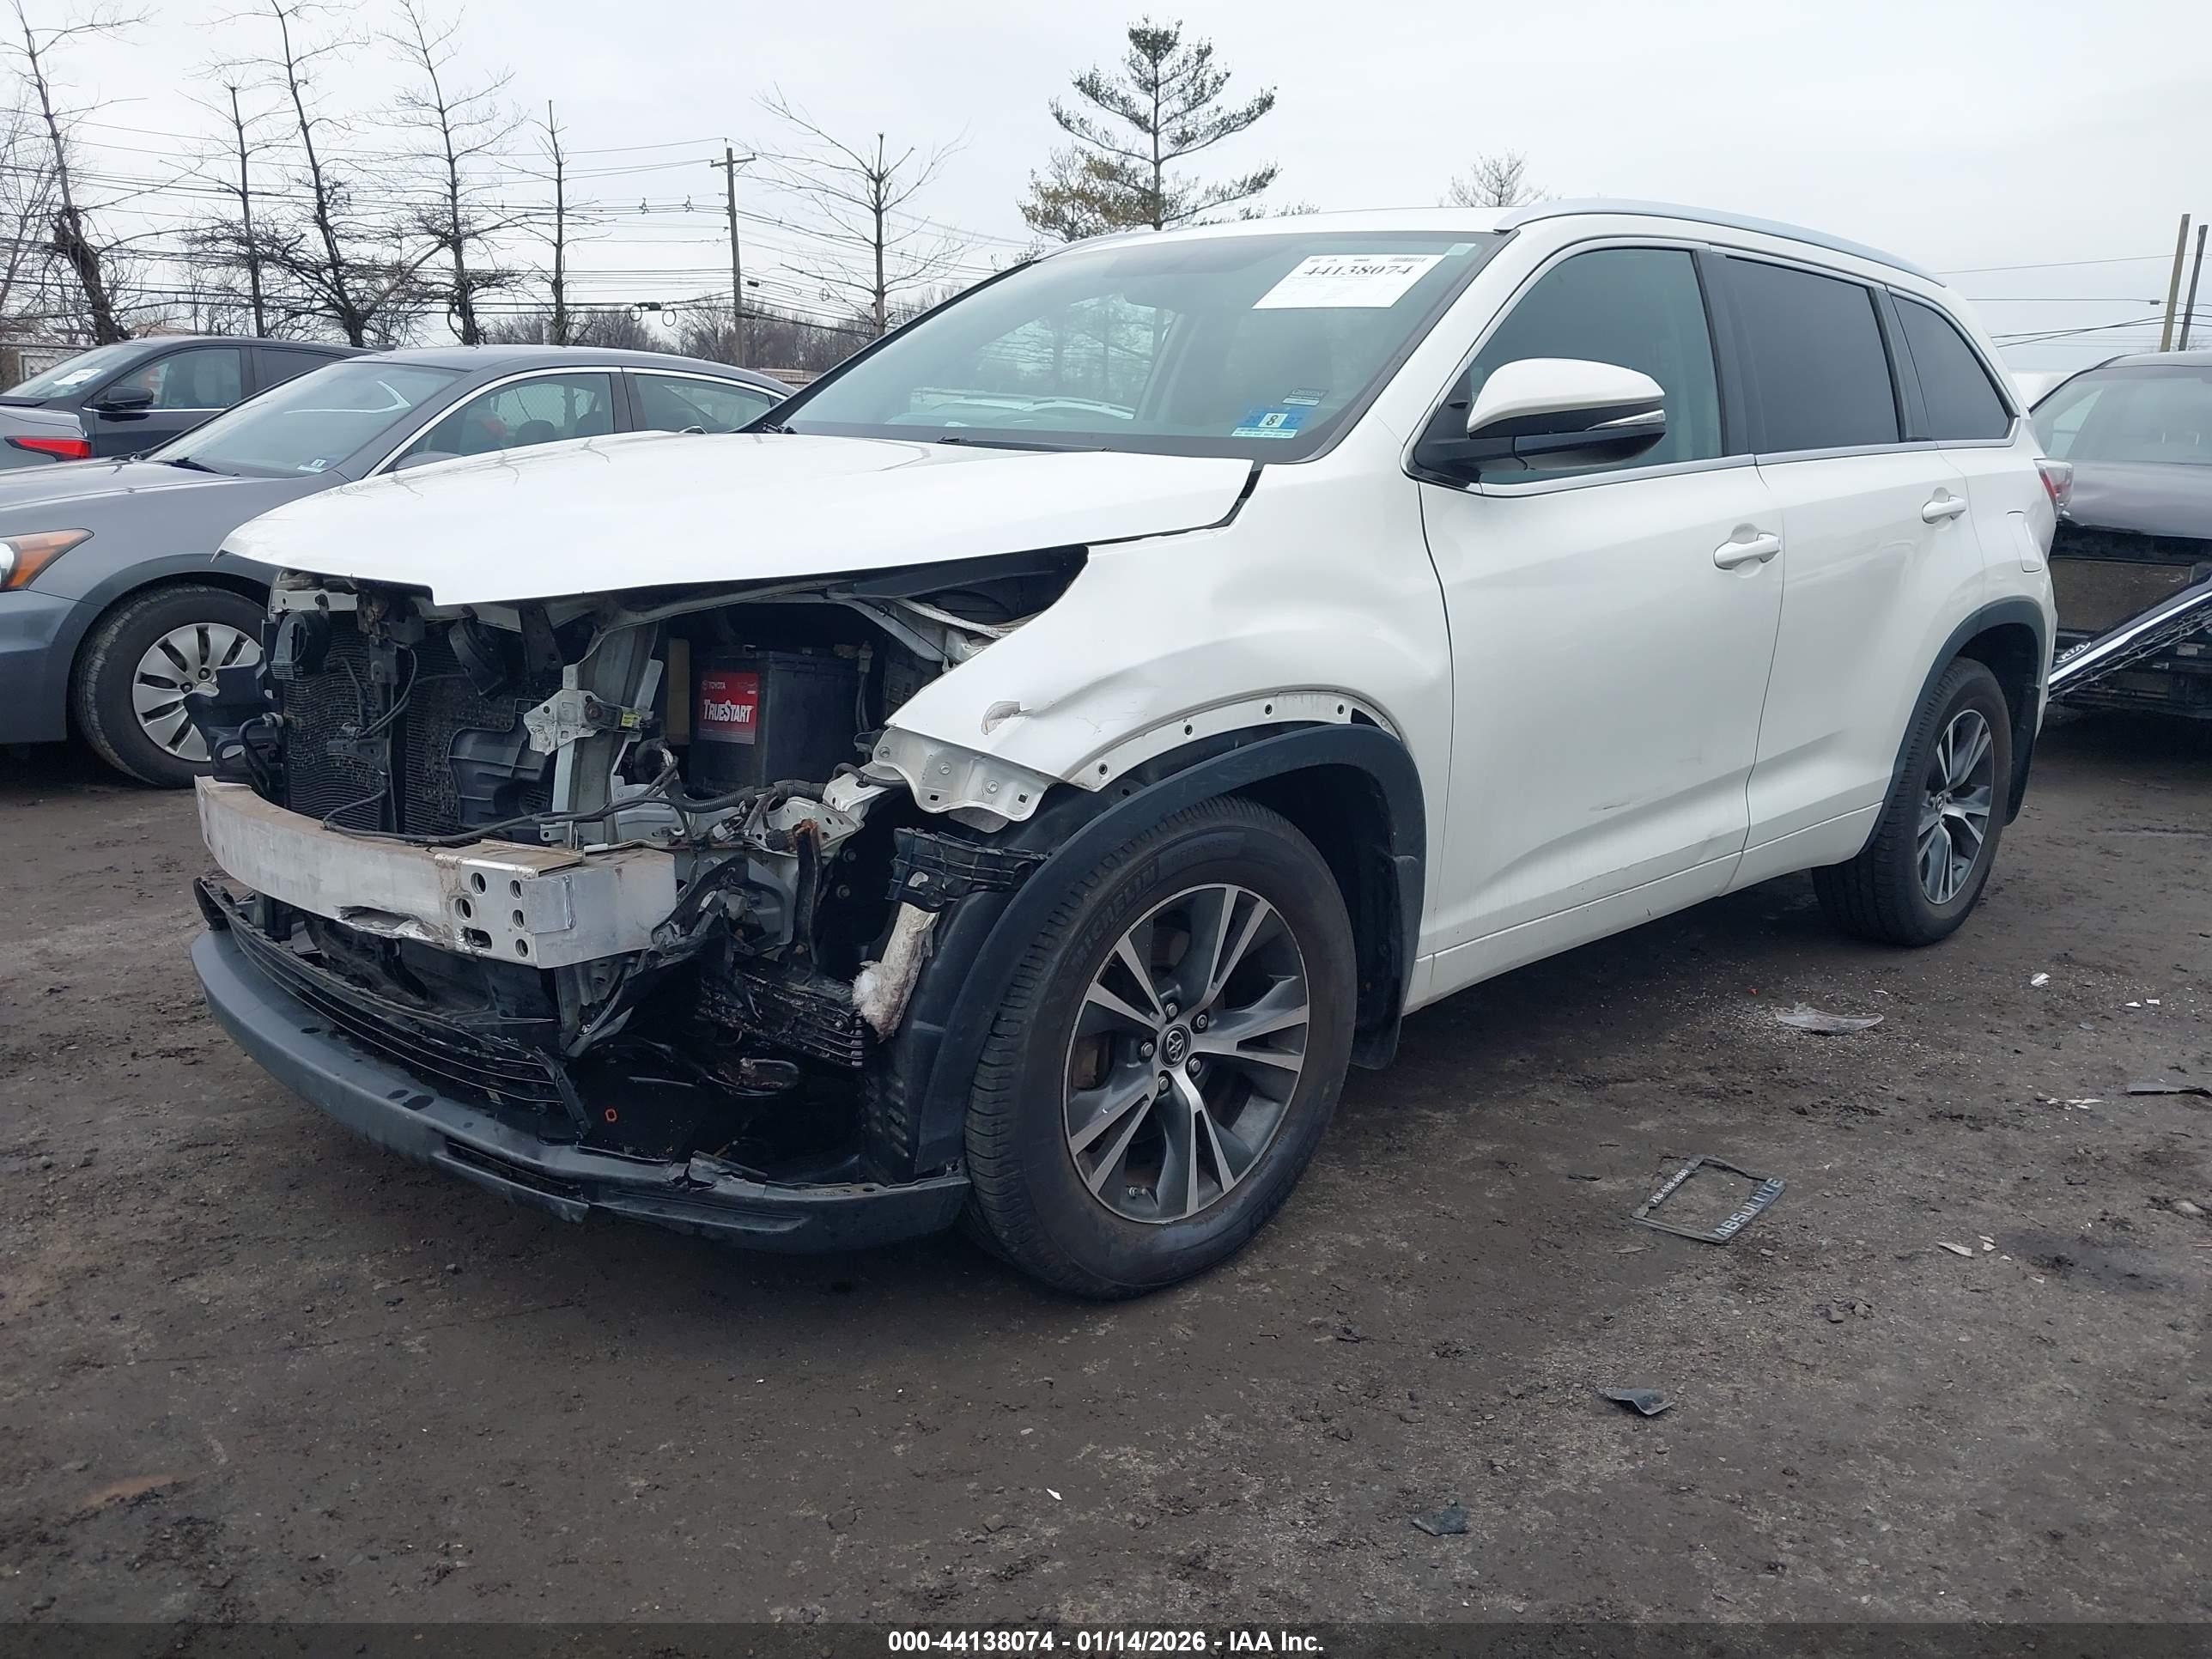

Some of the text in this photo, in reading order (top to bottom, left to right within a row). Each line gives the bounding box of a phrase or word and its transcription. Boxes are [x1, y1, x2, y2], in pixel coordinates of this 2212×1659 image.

[1303, 264, 1415, 276] 44138074
[1266, 414, 1279, 426] 8
[2061, 644, 2085, 659] KIA
